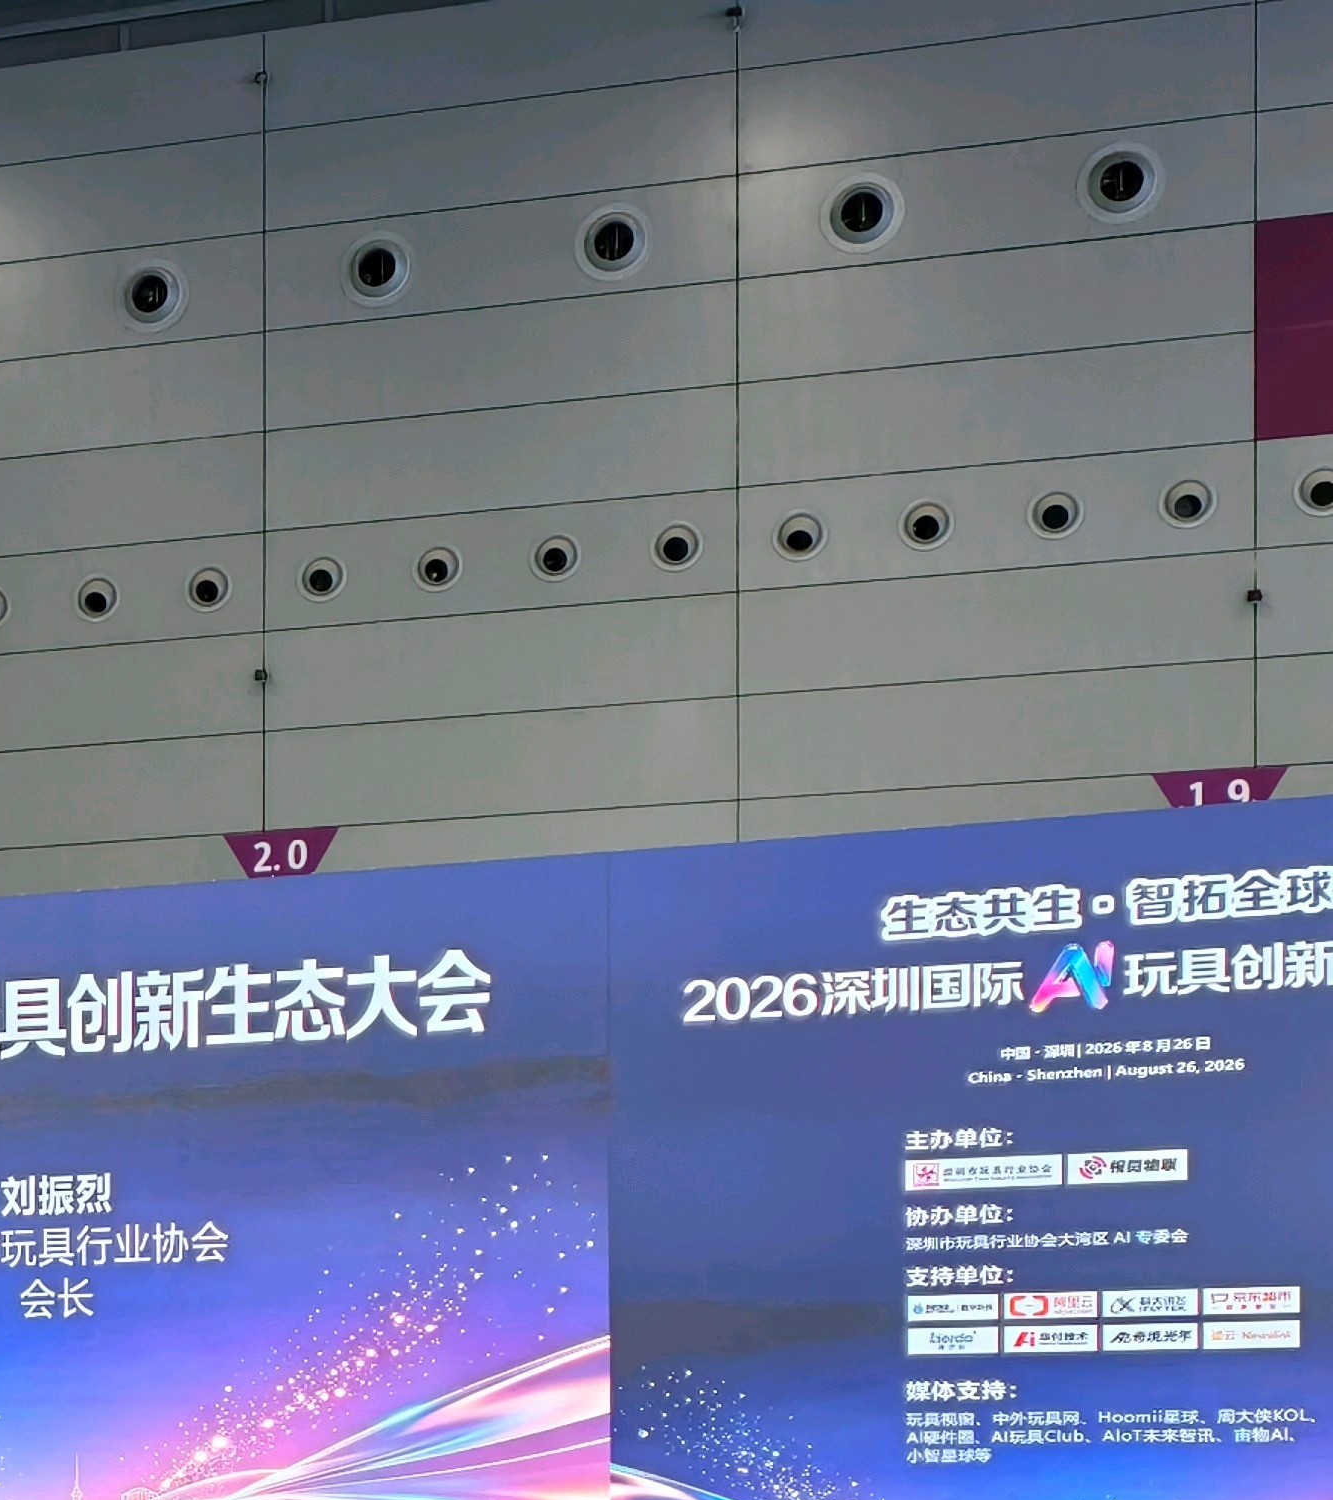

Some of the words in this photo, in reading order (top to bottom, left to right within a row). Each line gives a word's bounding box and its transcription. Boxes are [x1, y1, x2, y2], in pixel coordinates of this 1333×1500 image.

[1189, 778, 1250, 806] 19
[253, 839, 308, 872] 2.0
[967, 1071, 1013, 1085] China
[1026, 1066, 1103, 1082] Shenzhen
[1115, 1063, 1174, 1078] August
[1204, 1058, 1246, 1073] 2026
[0, 1173, 112, 1217] 刘振烈
[19, 1278, 94, 1319] 会长
